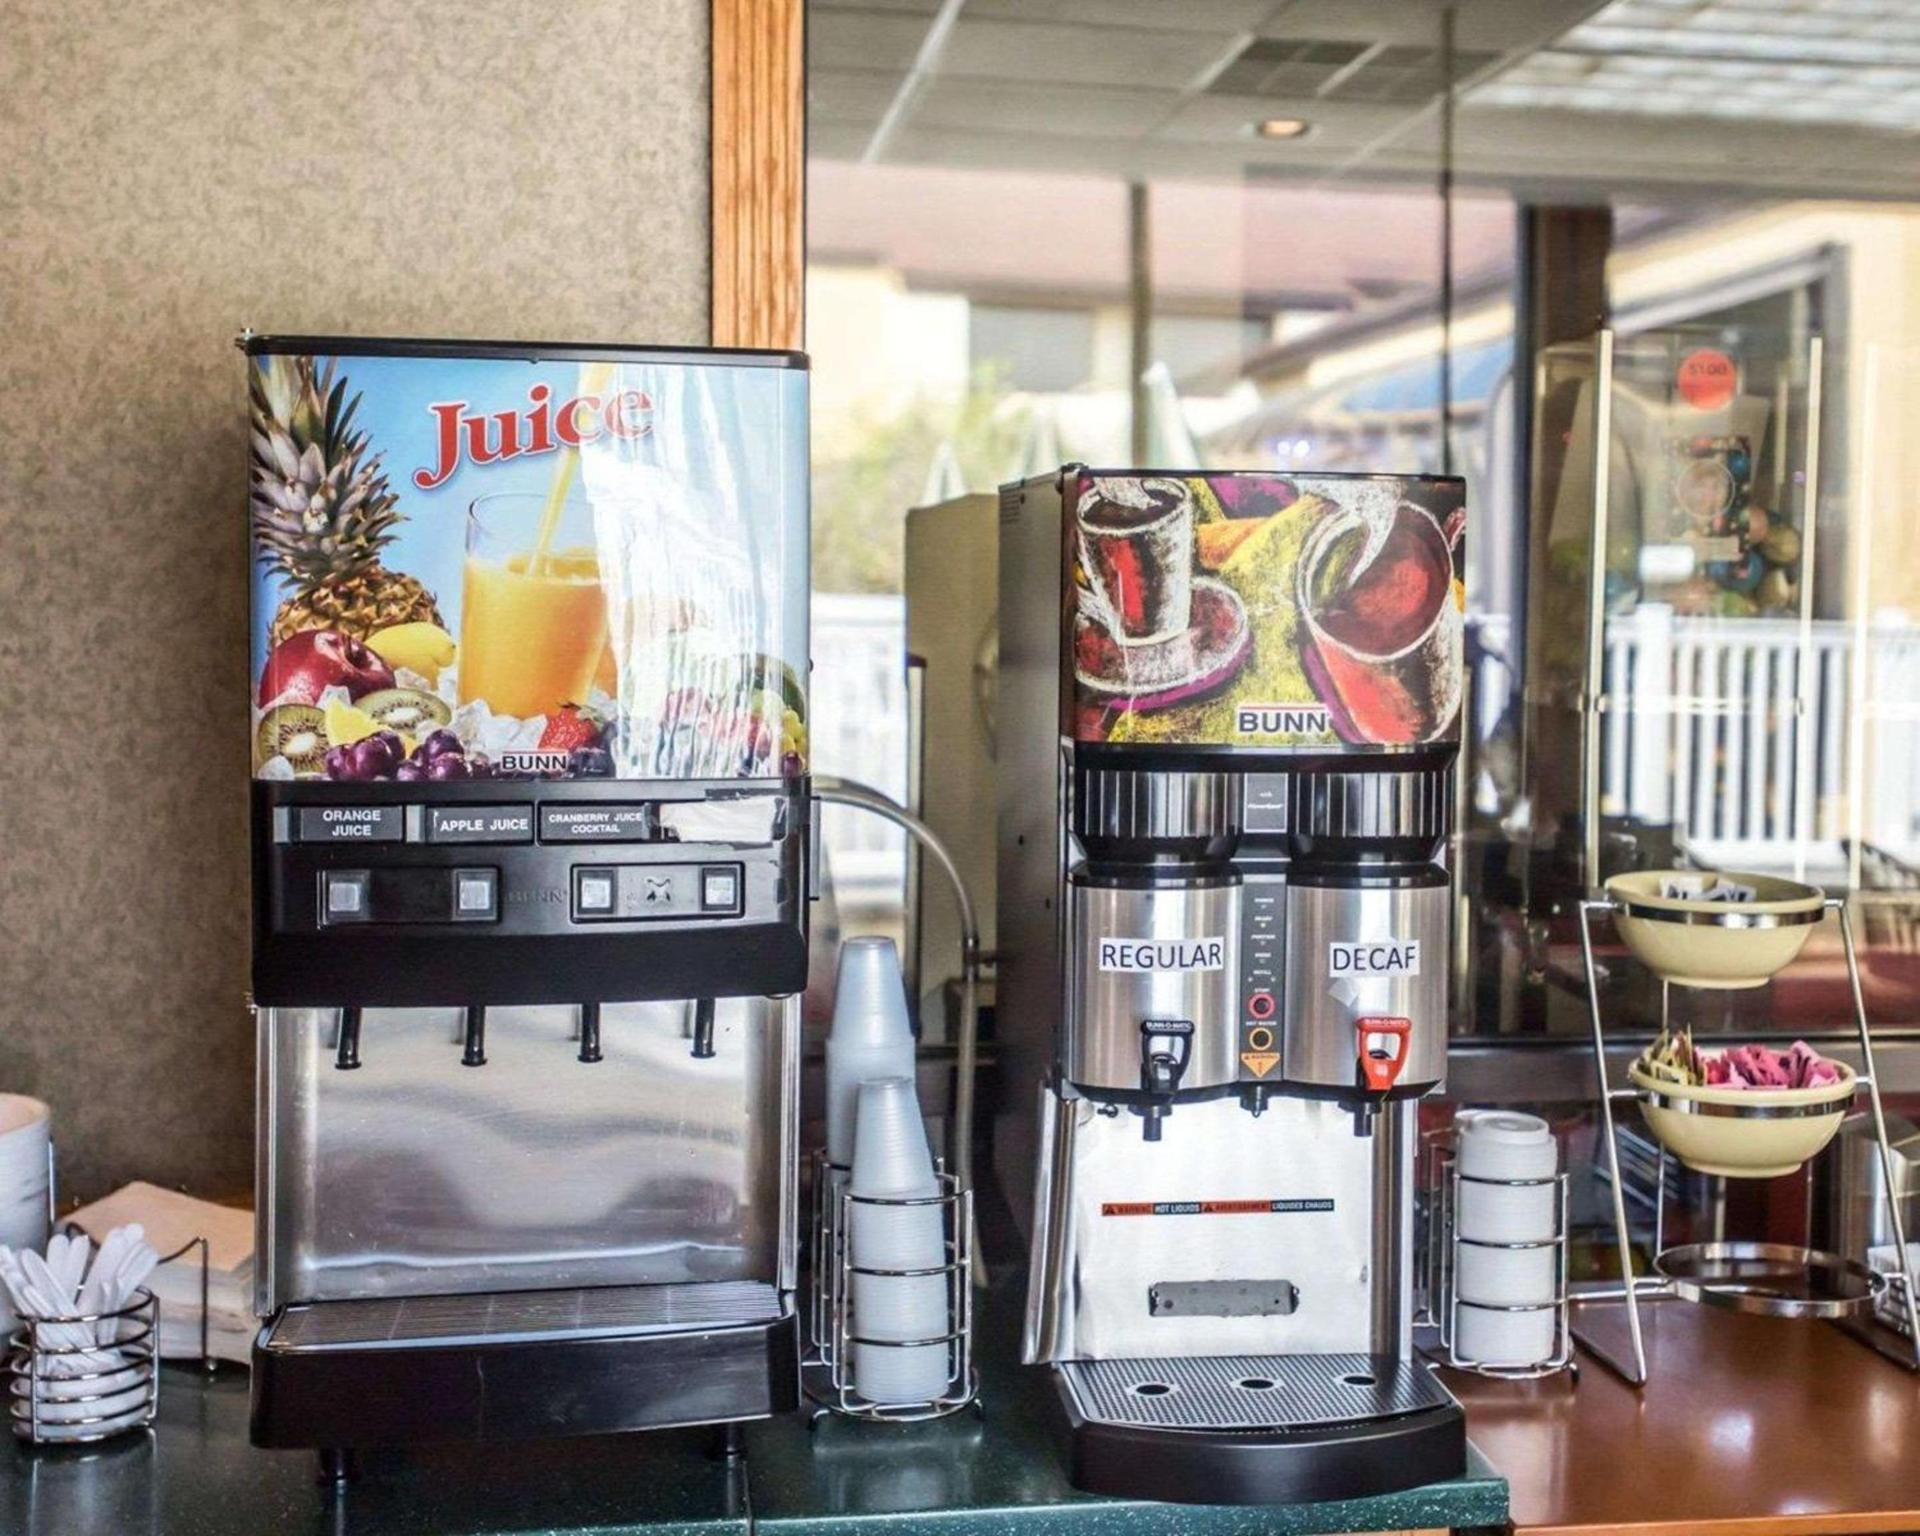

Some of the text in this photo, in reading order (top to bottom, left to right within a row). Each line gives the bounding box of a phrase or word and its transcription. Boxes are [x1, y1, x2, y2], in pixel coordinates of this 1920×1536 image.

[413, 384, 655, 488] Juice
[1239, 712, 1325, 732] BUNN
[502, 755, 567, 770] BUNN
[322, 809, 381, 822] ORANGE
[548, 812, 643, 823] CRANBERRY JUICE
[332, 824, 372, 836] JUICE
[440, 818, 529, 832] APPLE JUICE
[571, 824, 621, 834] COCKTAIL
[1101, 944, 1222, 968] REGULAR
[1332, 945, 1417, 971] DECAF
